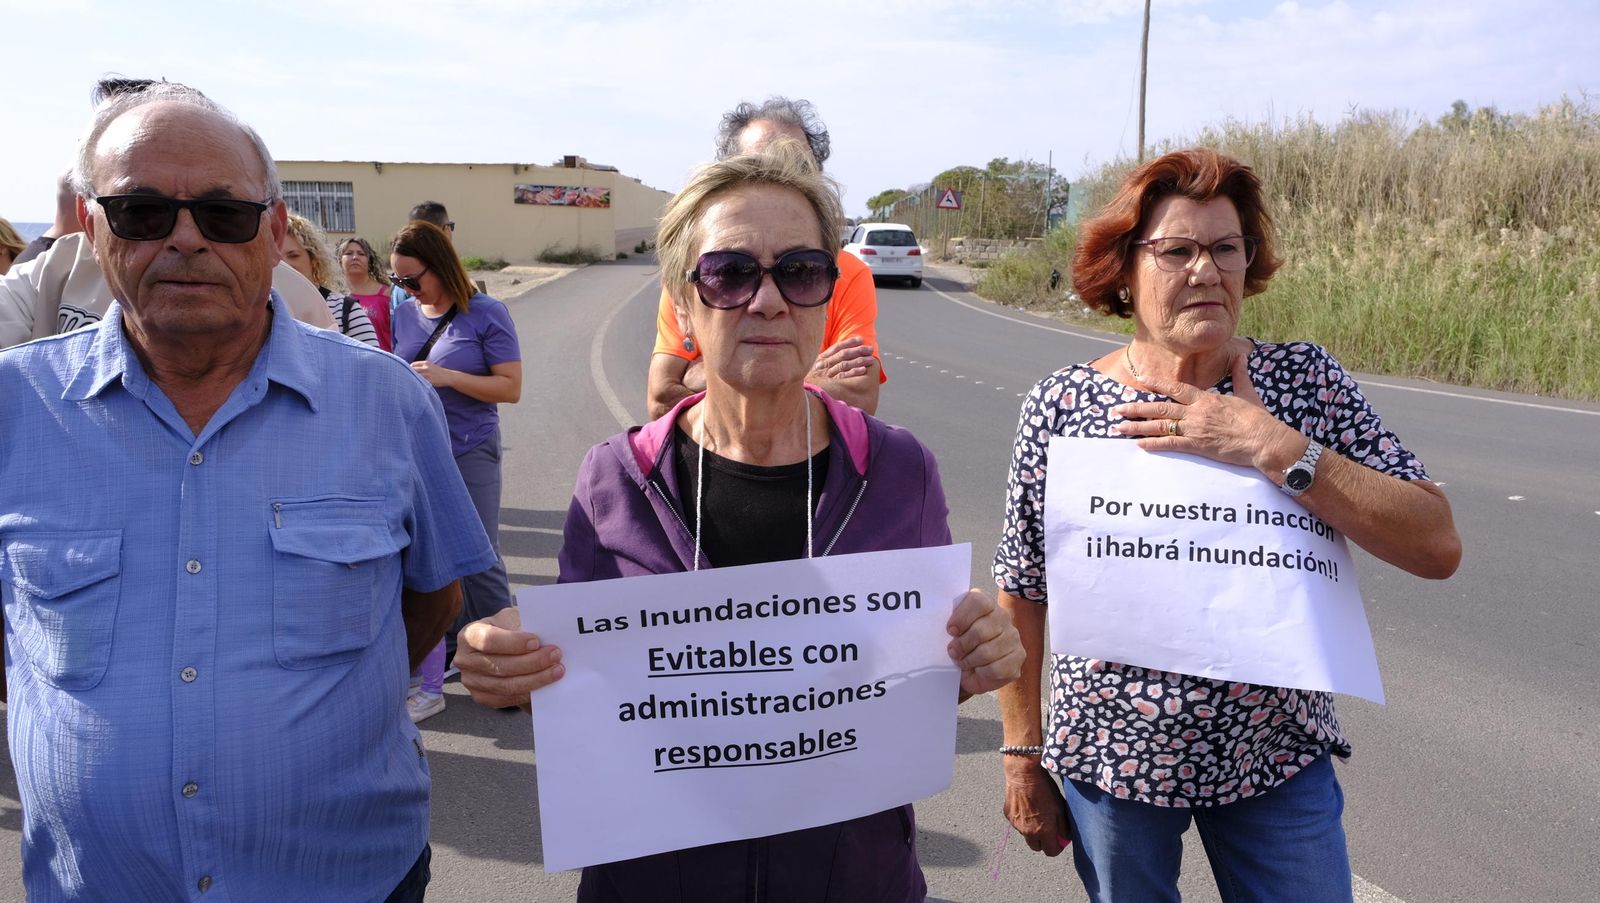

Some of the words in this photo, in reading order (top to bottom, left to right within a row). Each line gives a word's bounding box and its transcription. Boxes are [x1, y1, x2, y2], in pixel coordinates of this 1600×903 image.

[1090, 496, 1133, 516] Por
[1140, 502, 1237, 523] vuestra
[1246, 503, 1335, 543] inacción
[1087, 535, 1179, 561] ¡¡habrá
[1189, 540, 1339, 583] inundación!!
[576, 615, 630, 635] Las
[639, 594, 857, 628] Inundaciones
[866, 590, 922, 612] son
[648, 639, 794, 673] Evitables
[802, 643, 859, 665] con
[617, 680, 888, 723] administraciones
[653, 728, 858, 771] responsables
